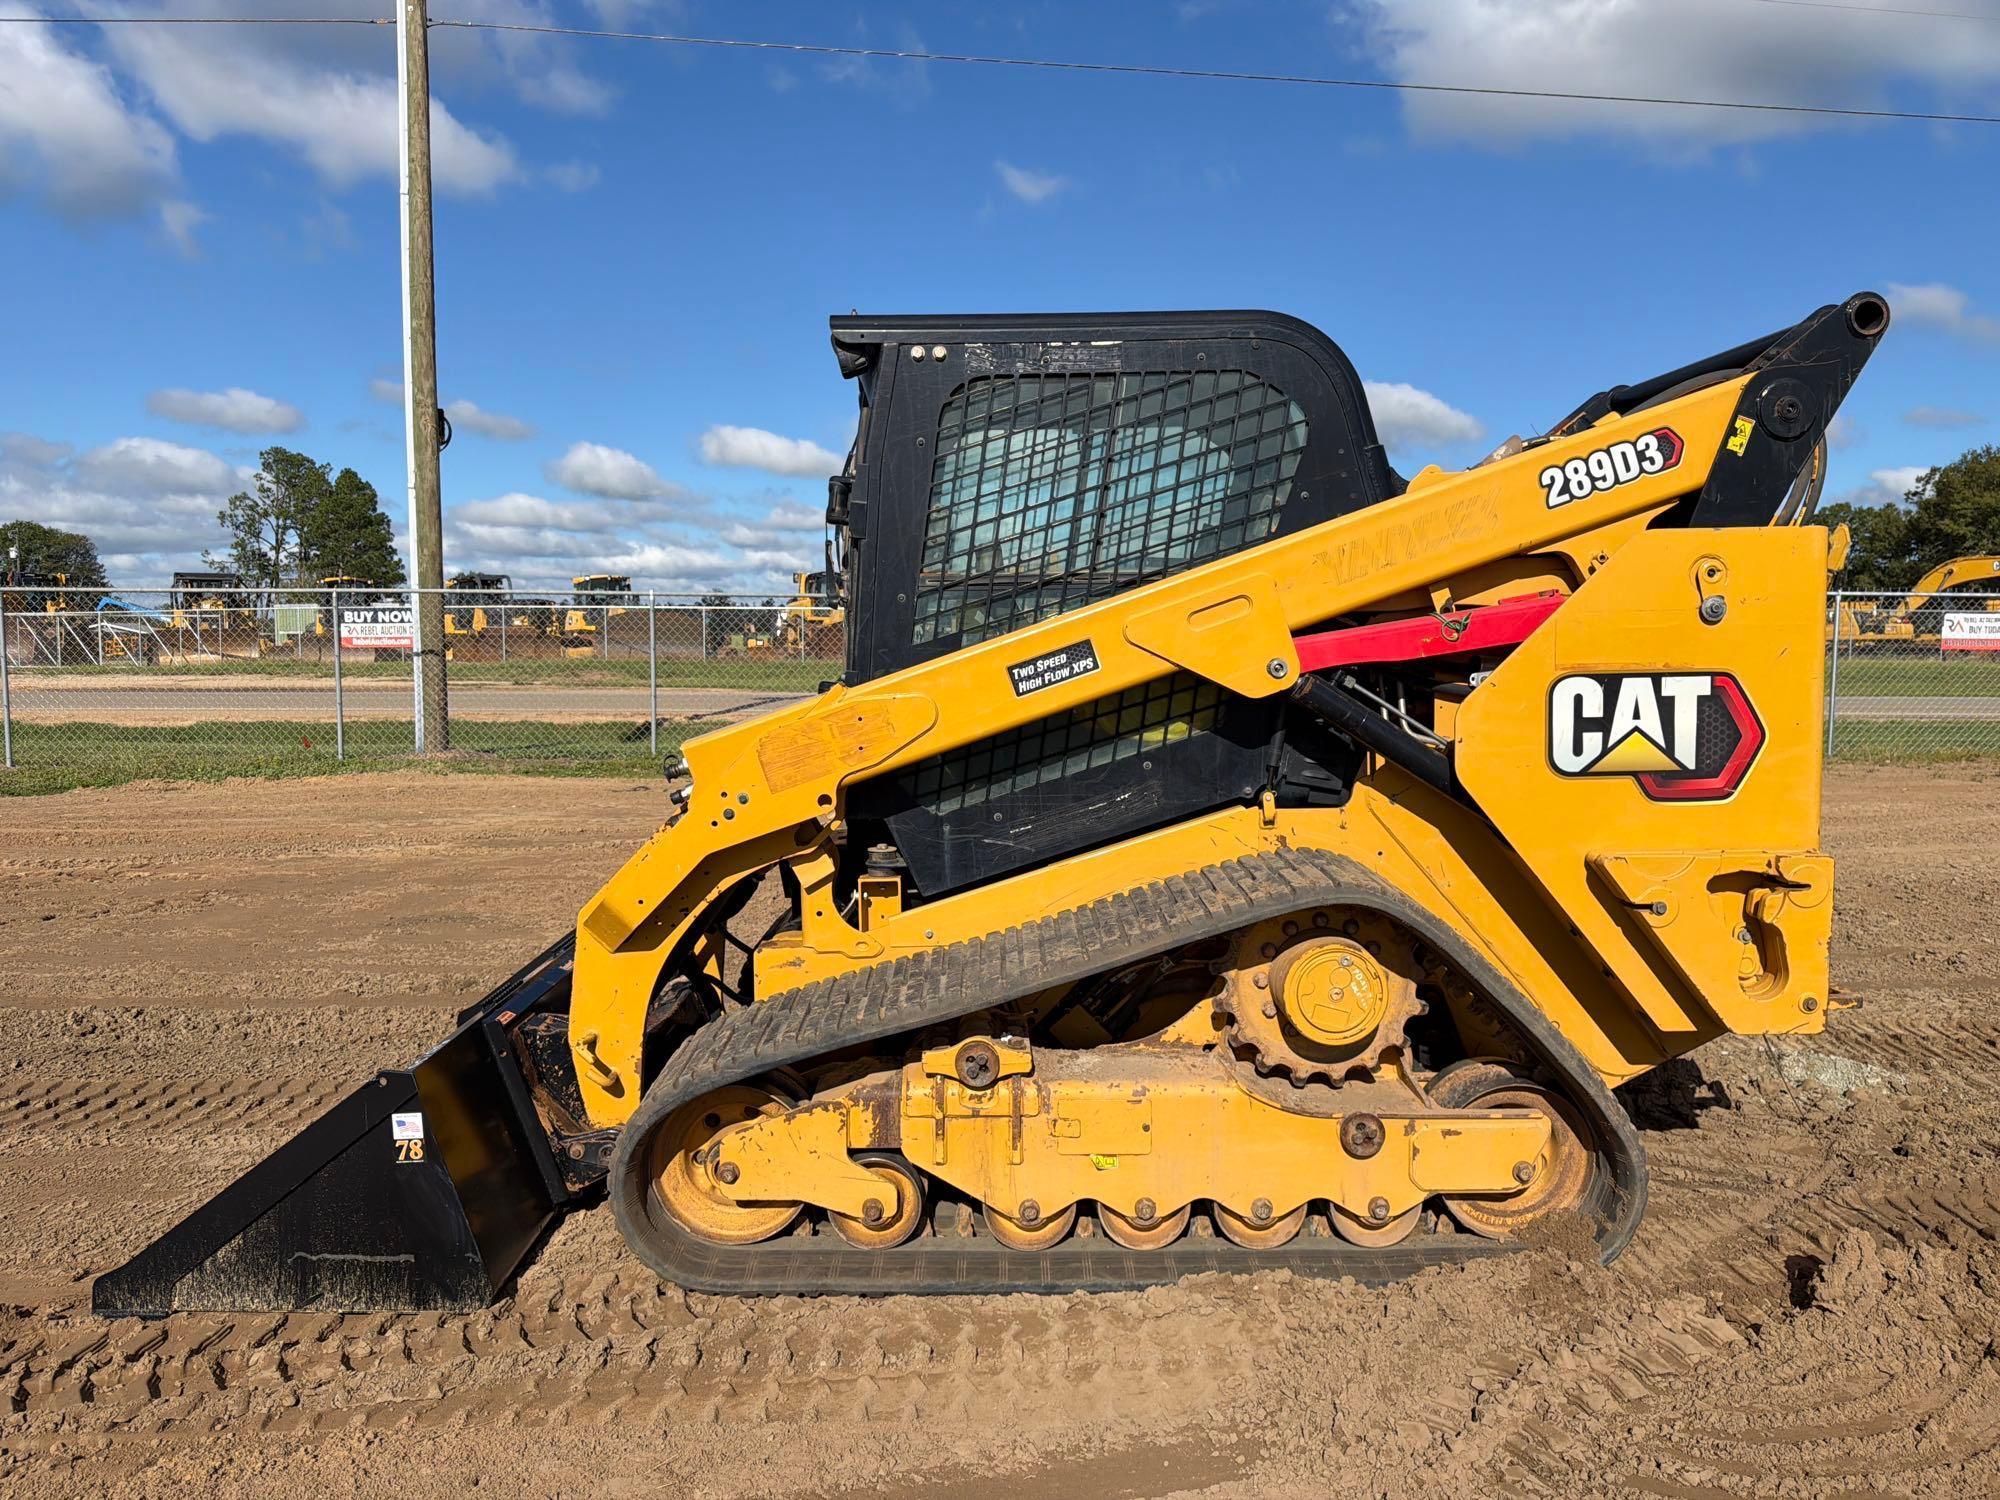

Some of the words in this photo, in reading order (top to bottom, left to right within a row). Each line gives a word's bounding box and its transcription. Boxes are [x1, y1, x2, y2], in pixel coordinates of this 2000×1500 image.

[1540, 434, 1664, 507] 289D3
[344, 610, 374, 623] BUY
[377, 610, 413, 623] NOW
[360, 625, 378, 635] REBEL
[381, 625, 407, 635] AUCTION
[1968, 625, 1983, 634] BUY
[1072, 657, 1094, 674] XPS
[1552, 676, 1712, 773] CAT
[395, 1139, 424, 1160] 78
